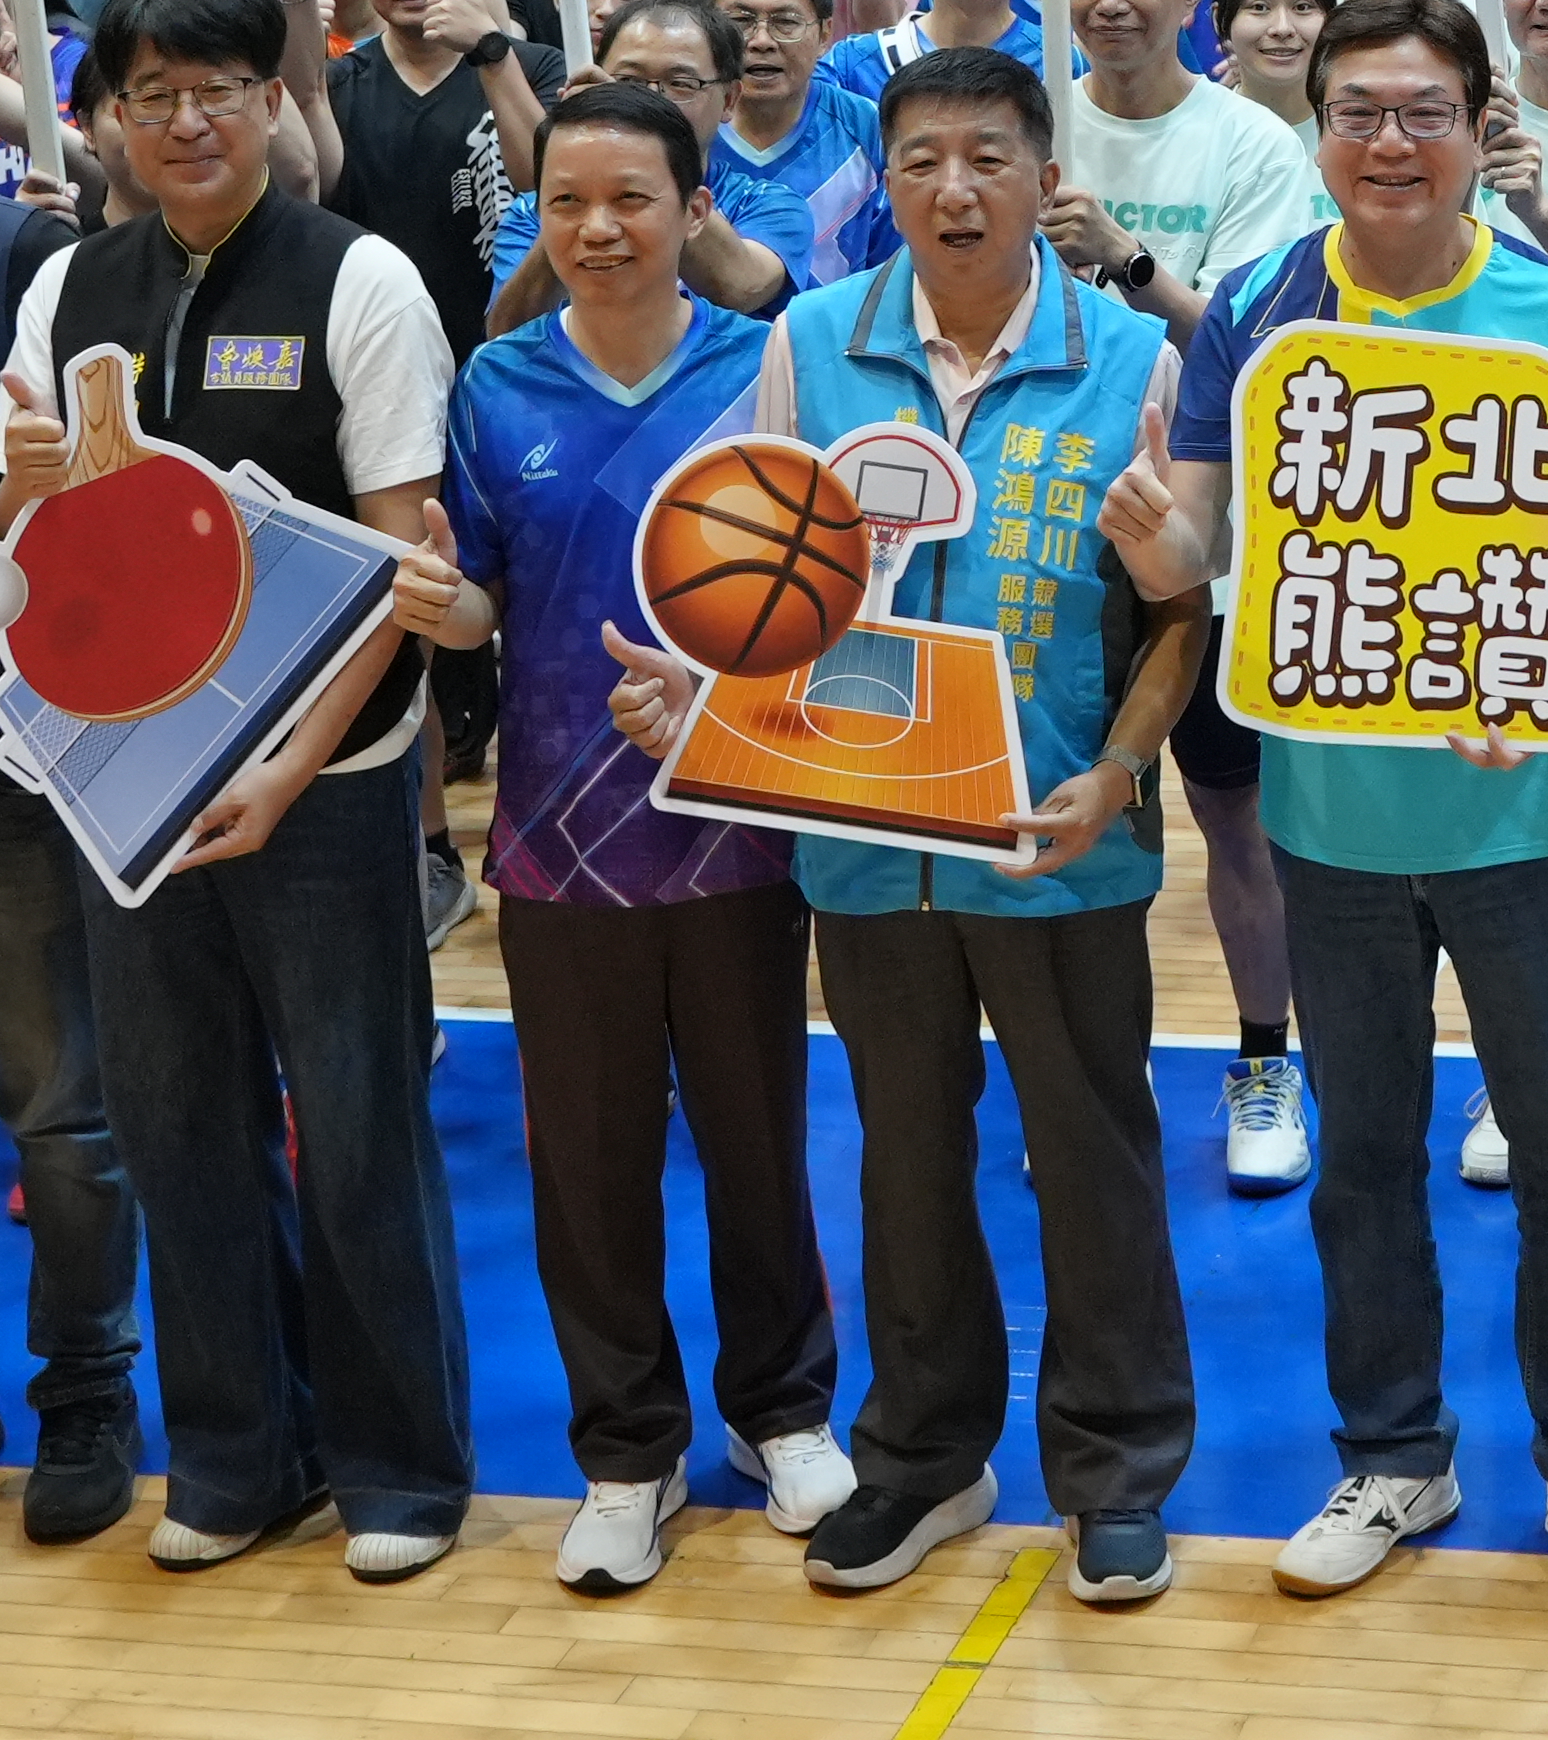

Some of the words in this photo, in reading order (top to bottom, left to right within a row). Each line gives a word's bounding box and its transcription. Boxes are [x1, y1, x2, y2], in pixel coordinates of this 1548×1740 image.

[986, 423, 1045, 561] 陳鴻源
[1039, 433, 1095, 572] 李四川
[997, 574, 1026, 635] 服務
[1030, 578, 1058, 638] 競選
